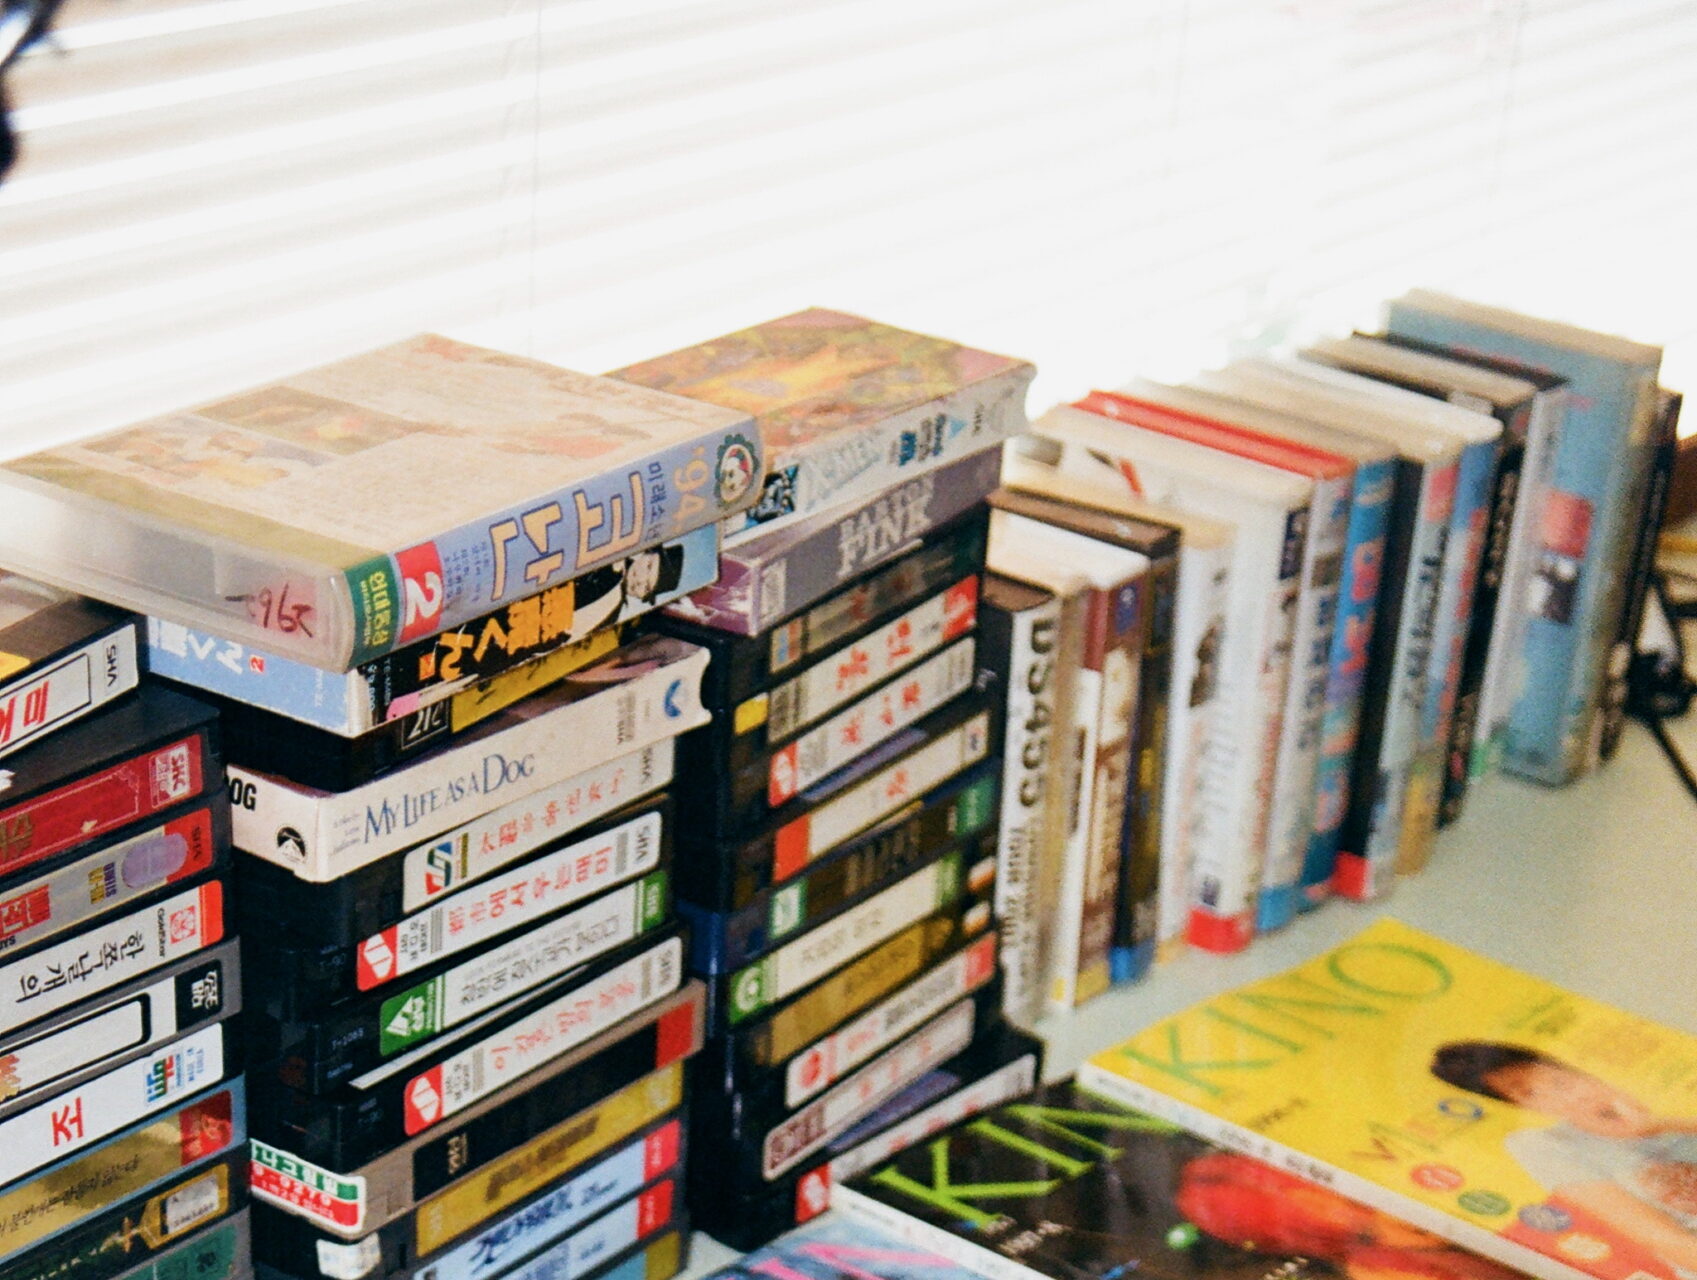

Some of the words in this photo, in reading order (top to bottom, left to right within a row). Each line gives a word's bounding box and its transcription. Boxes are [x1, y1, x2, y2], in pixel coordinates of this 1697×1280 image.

[405, 571, 443, 627] 2
[105, 643, 117, 687] VHS
[228, 776, 257, 810] OG
[1122, 941, 1454, 1098] KINO
